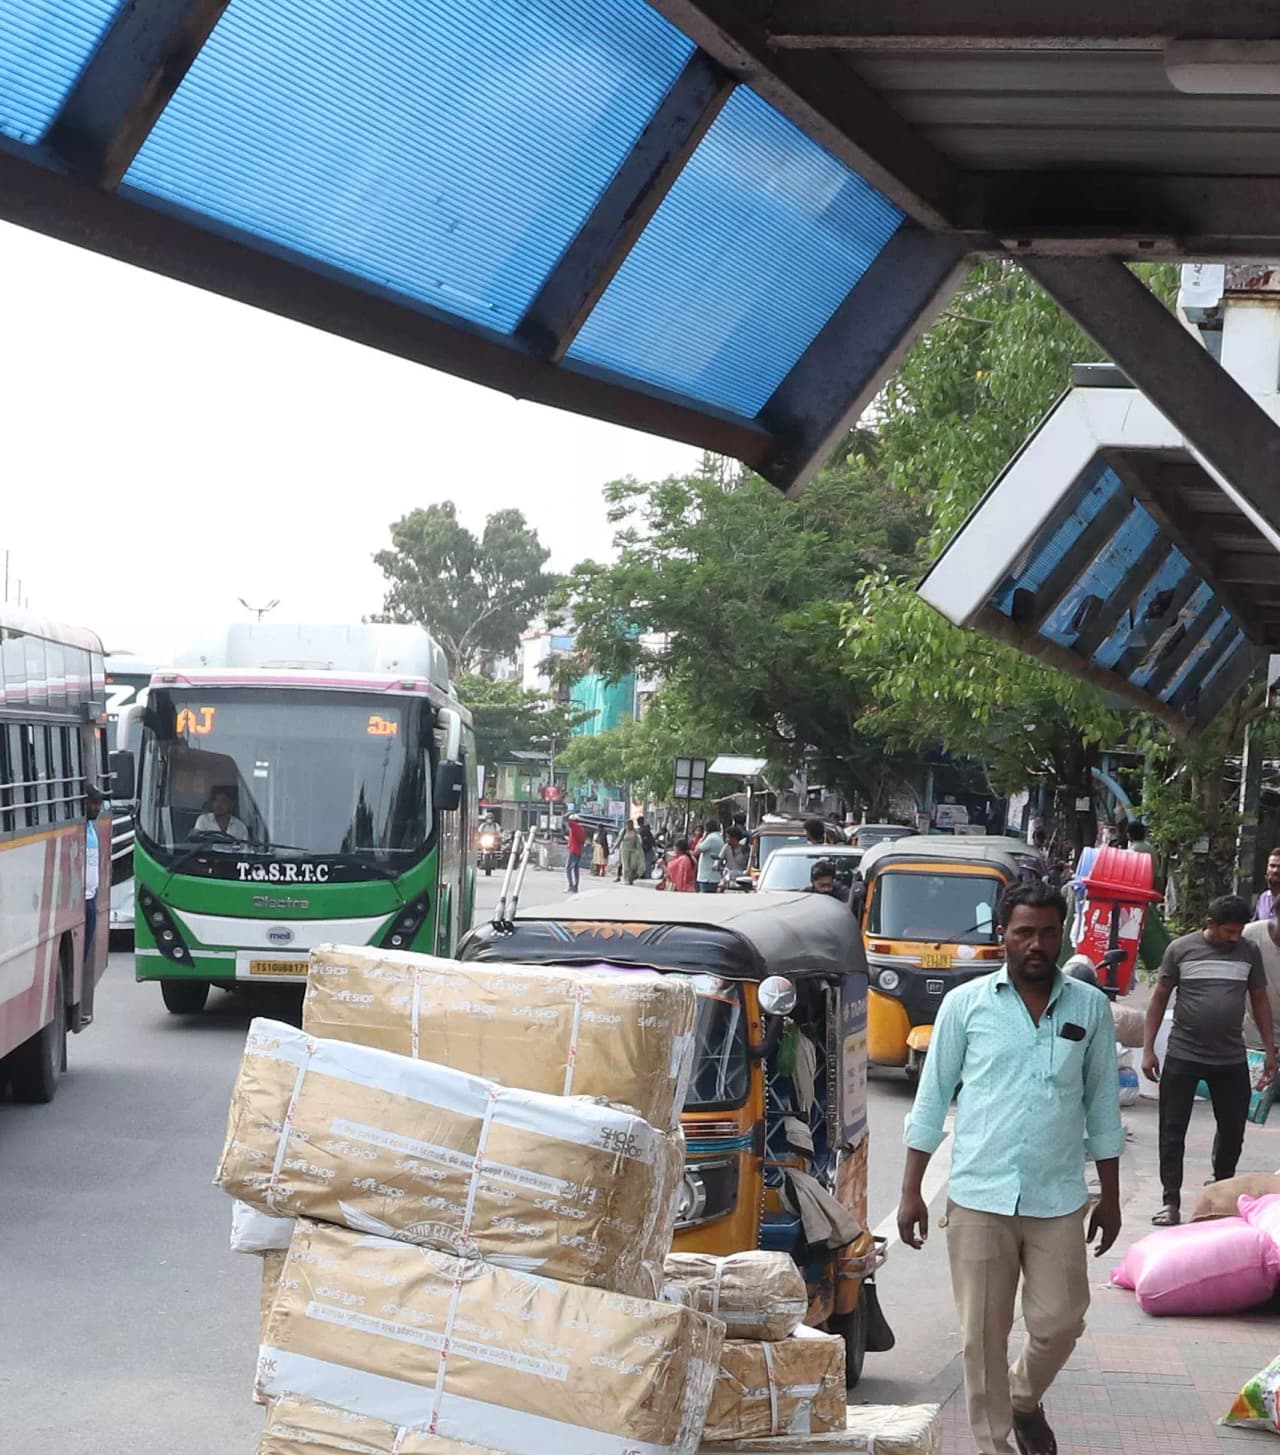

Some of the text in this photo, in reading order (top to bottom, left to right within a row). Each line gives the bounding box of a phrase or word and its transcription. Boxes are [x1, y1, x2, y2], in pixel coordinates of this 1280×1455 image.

[283, 1158, 336, 1179] SAFE SHOP
[352, 1177, 406, 1198] SAFE SHOP
[533, 1198, 587, 1219] SAFE SHOP
[490, 1216, 545, 1238] SAFE SHOP
